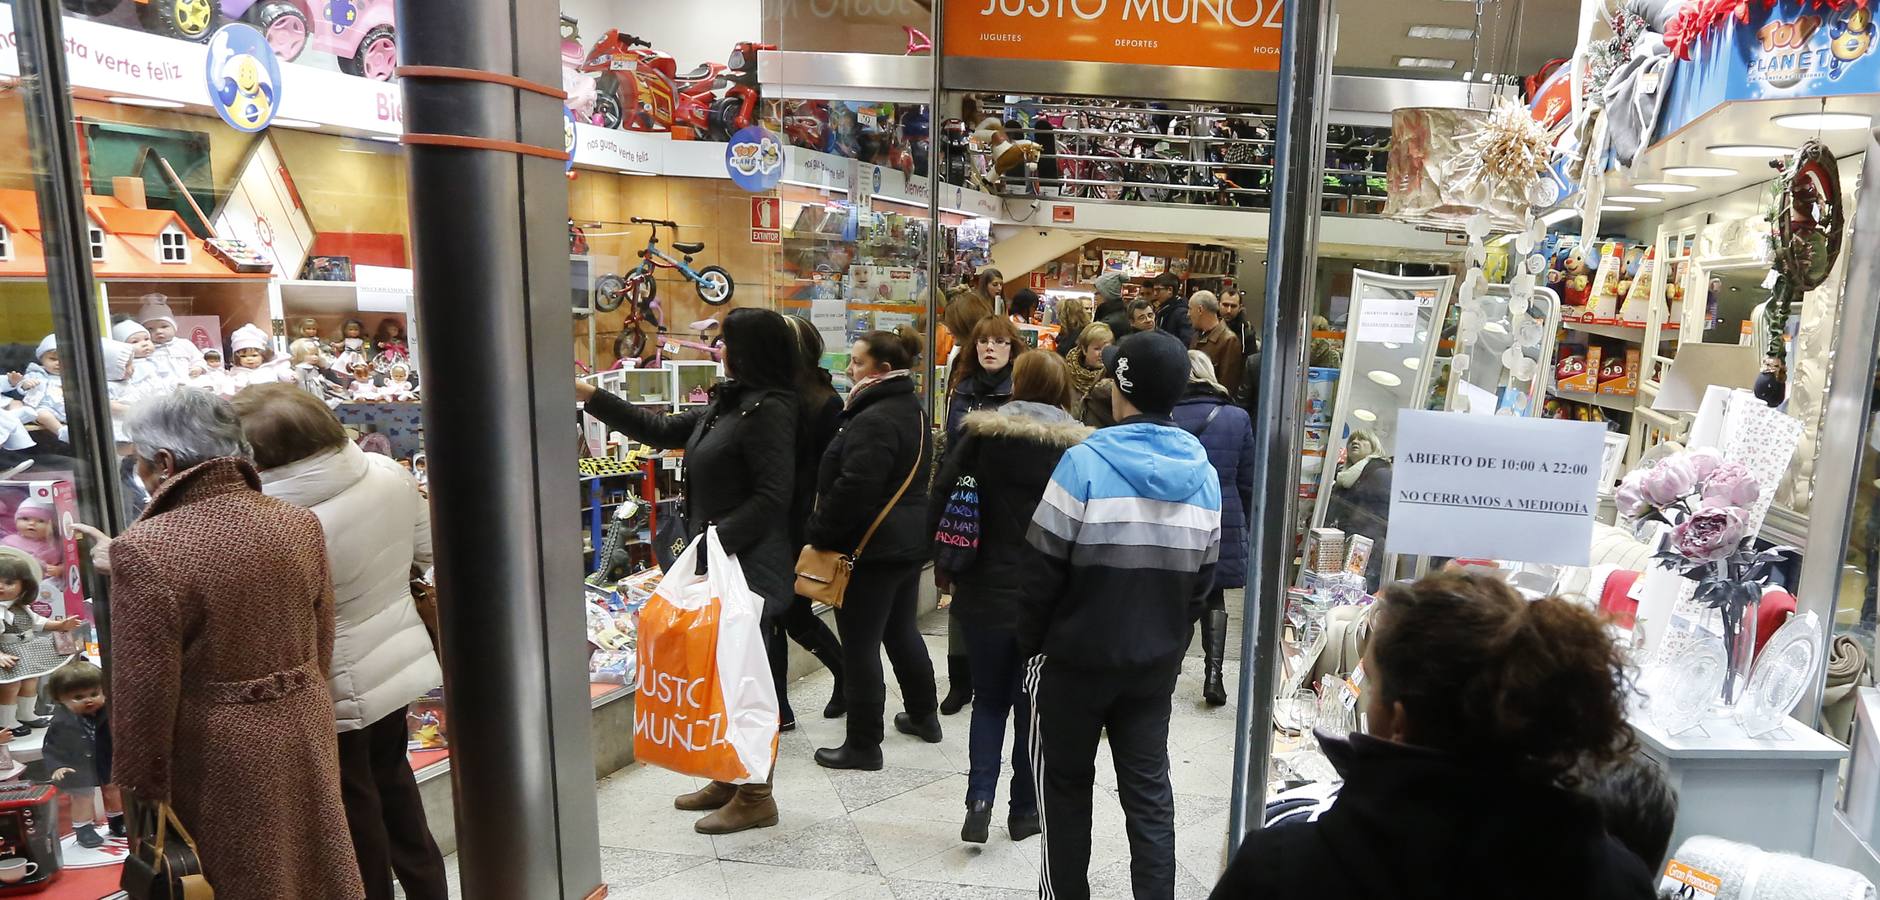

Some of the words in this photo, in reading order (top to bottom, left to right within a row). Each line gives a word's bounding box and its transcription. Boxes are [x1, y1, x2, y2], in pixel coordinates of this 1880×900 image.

[980, 33, 1022, 42] JUGUETES
[1114, 39, 1159, 48] DEPORTES
[1253, 46, 1280, 55] HOGA
[1757, 15, 1822, 51] TOY
[95, 49, 141, 78] verte
[147, 61, 183, 81] feliz
[1747, 48, 1830, 74] PLANET
[587, 139, 599, 151] nos
[600, 140, 617, 153] gusta
[619, 148, 635, 162] verte
[636, 150, 649, 163] feliz
[731, 158, 763, 166] PLANET
[734, 145, 758, 157] TOY
[753, 231, 779, 241] EXTINTOR
[1404, 452, 1472, 467] ABIERTO
[1476, 457, 1497, 469] DE
[1501, 458, 1535, 472] 10:00
[1538, 462, 1549, 472] A
[1553, 462, 1588, 475] 22:00
[1400, 490, 1419, 501] NO
[1423, 491, 1501, 507] CERRAMOS
[1504, 498, 1513, 508] A
[1518, 498, 1589, 514] MEDIODÍA
[1668, 864, 1685, 878] Gran
